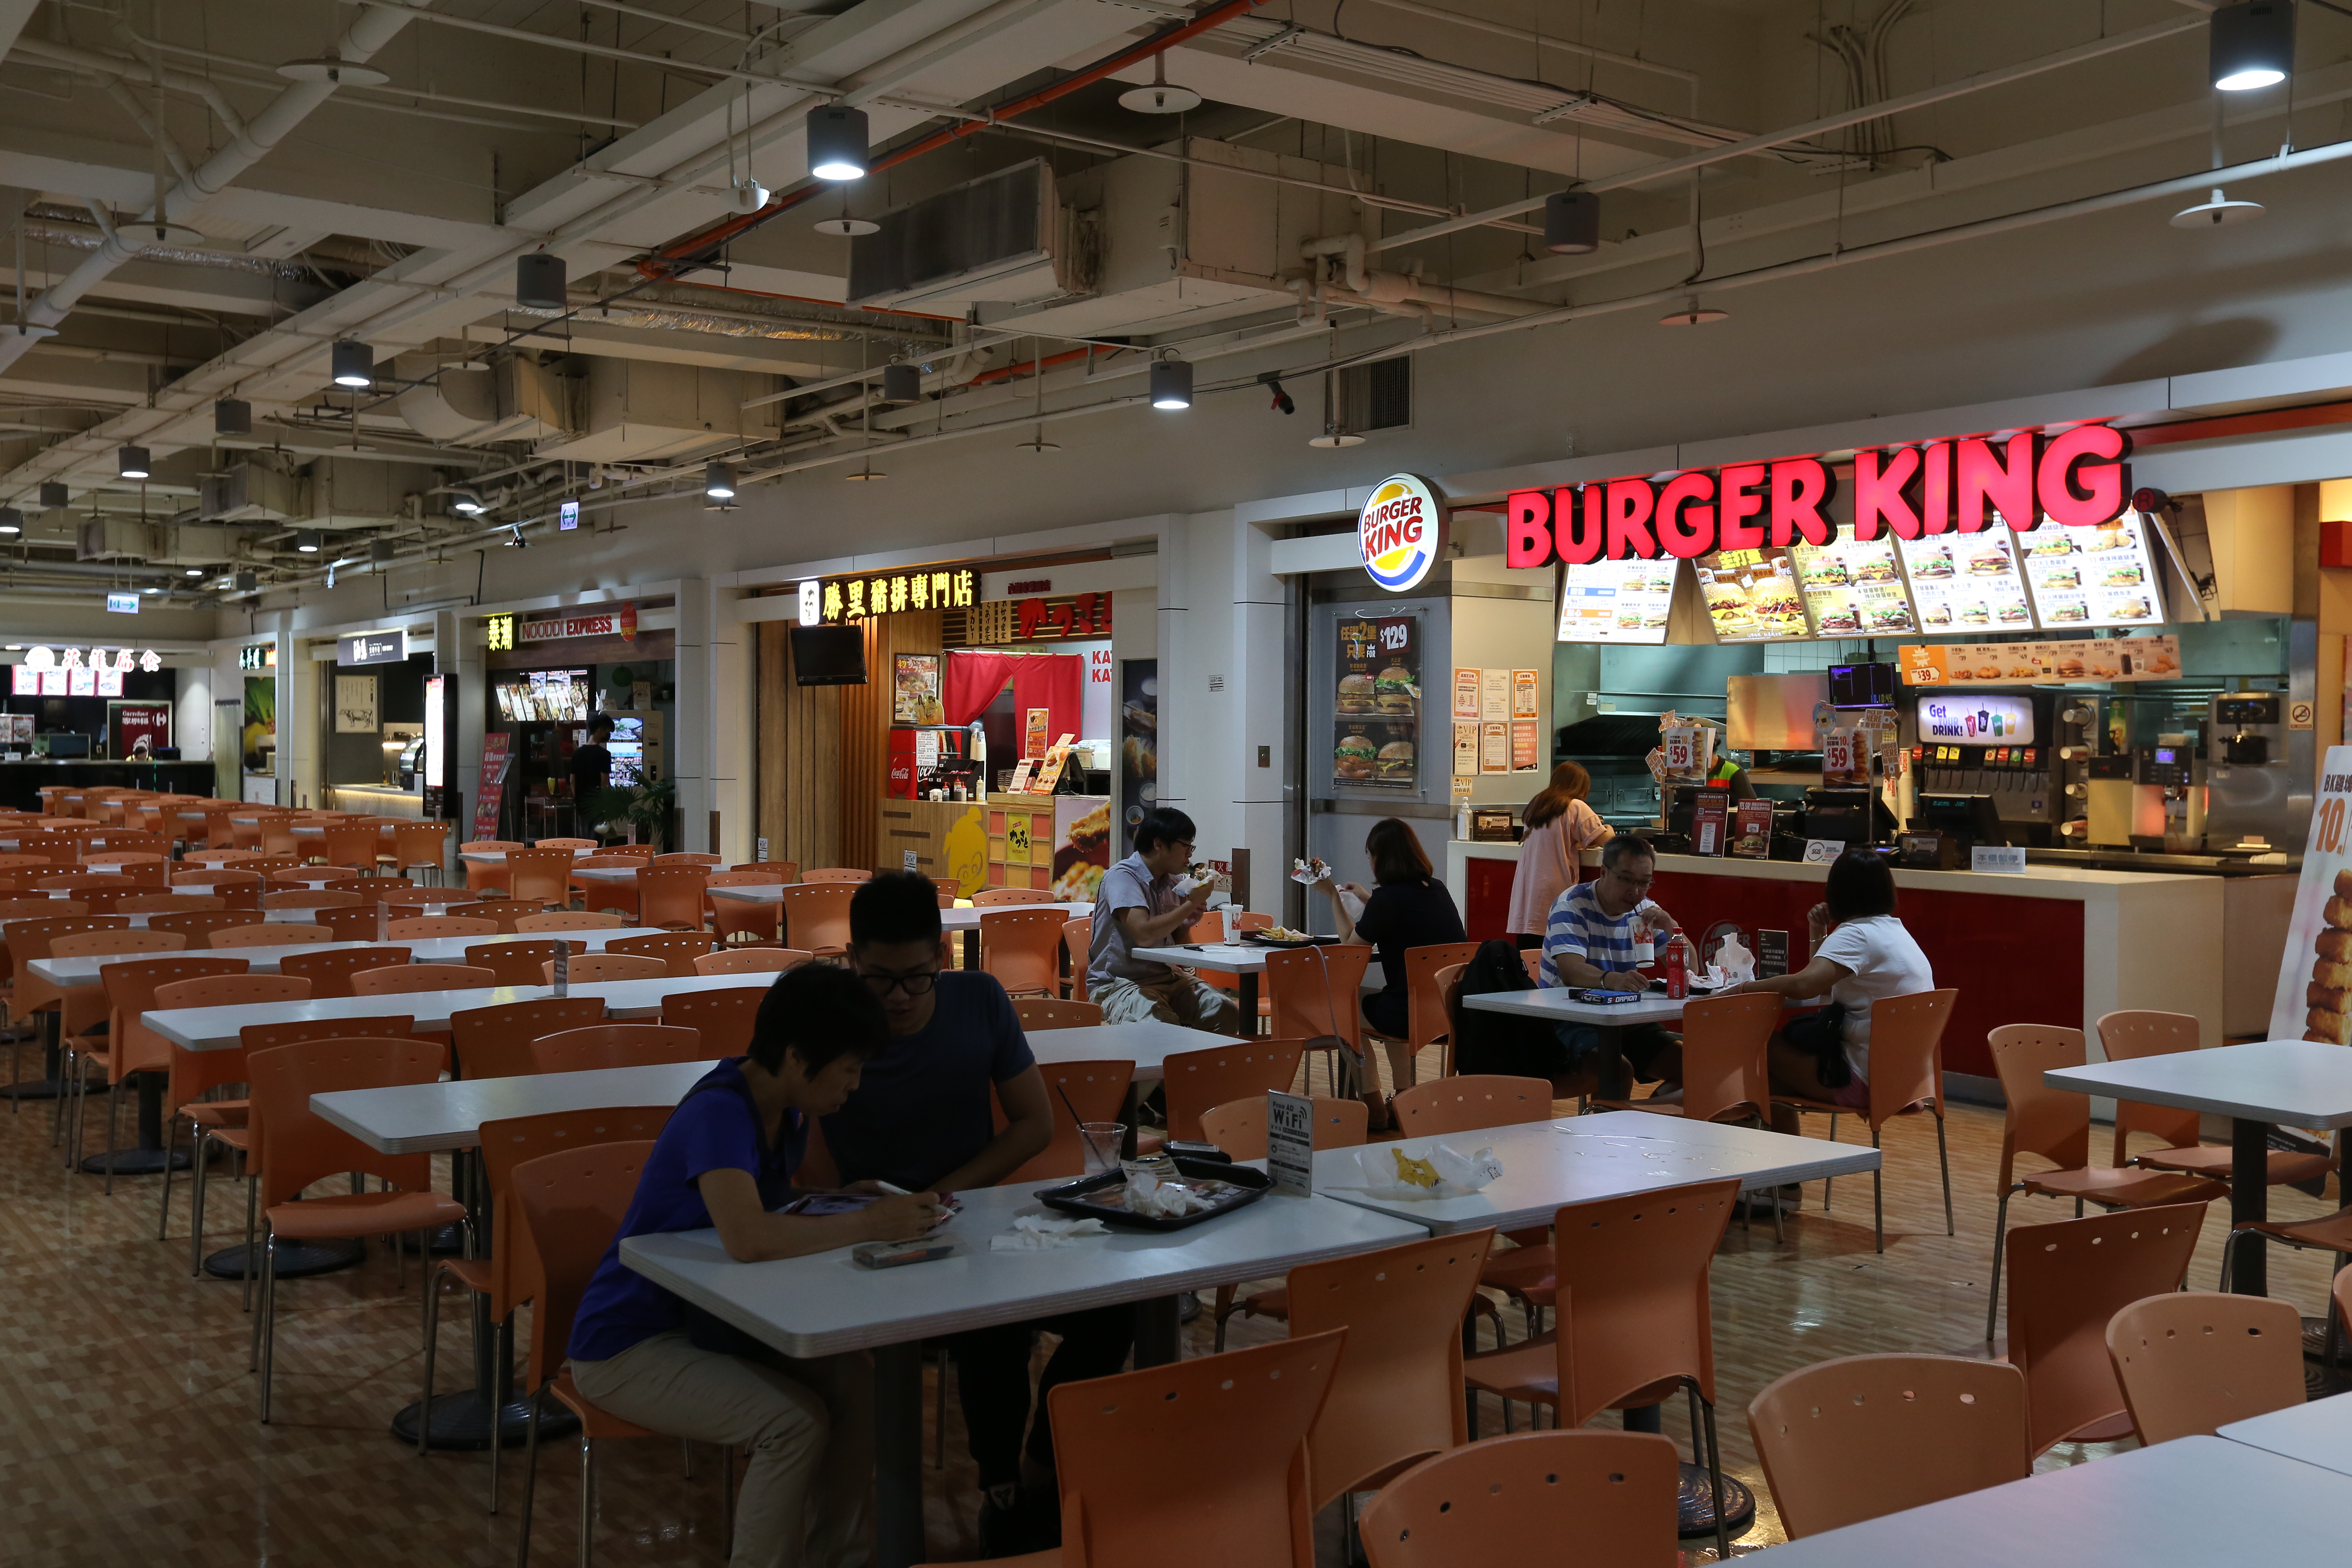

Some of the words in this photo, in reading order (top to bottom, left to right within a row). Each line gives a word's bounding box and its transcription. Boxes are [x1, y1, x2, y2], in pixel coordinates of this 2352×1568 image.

[1507, 458, 1836, 569] BURGER
[1854, 424, 2132, 541] KING
[1364, 497, 1422, 535] BURGER
[1365, 516, 1423, 563] KING
[822, 570, 973, 621] 勝里豬排專門店
[488, 615, 512, 651] 泰潮
[522, 619, 564, 639] NOODDI
[566, 615, 612, 636] EXPRESS
[1380, 624, 1408, 650] $129
[1092, 650, 1112, 664] KA
[1346, 644, 1365, 659] 只要
[1092, 669, 1112, 682] KA
[1918, 670, 1931, 681] $39
[1929, 704, 1947, 718] Get
[1463, 725, 1476, 733] VIP
[1939, 717, 1958, 726] YOUR
[1933, 725, 1963, 736] DRINK!
[1670, 746, 1688, 764] $59
[1827, 747, 1847, 767] $59
[891, 768, 909, 779] Coca-Cola
[1273, 1101, 1285, 1109] Free
[1286, 1103, 1294, 1111] AD
[1273, 1108, 1302, 1129] WiFi
